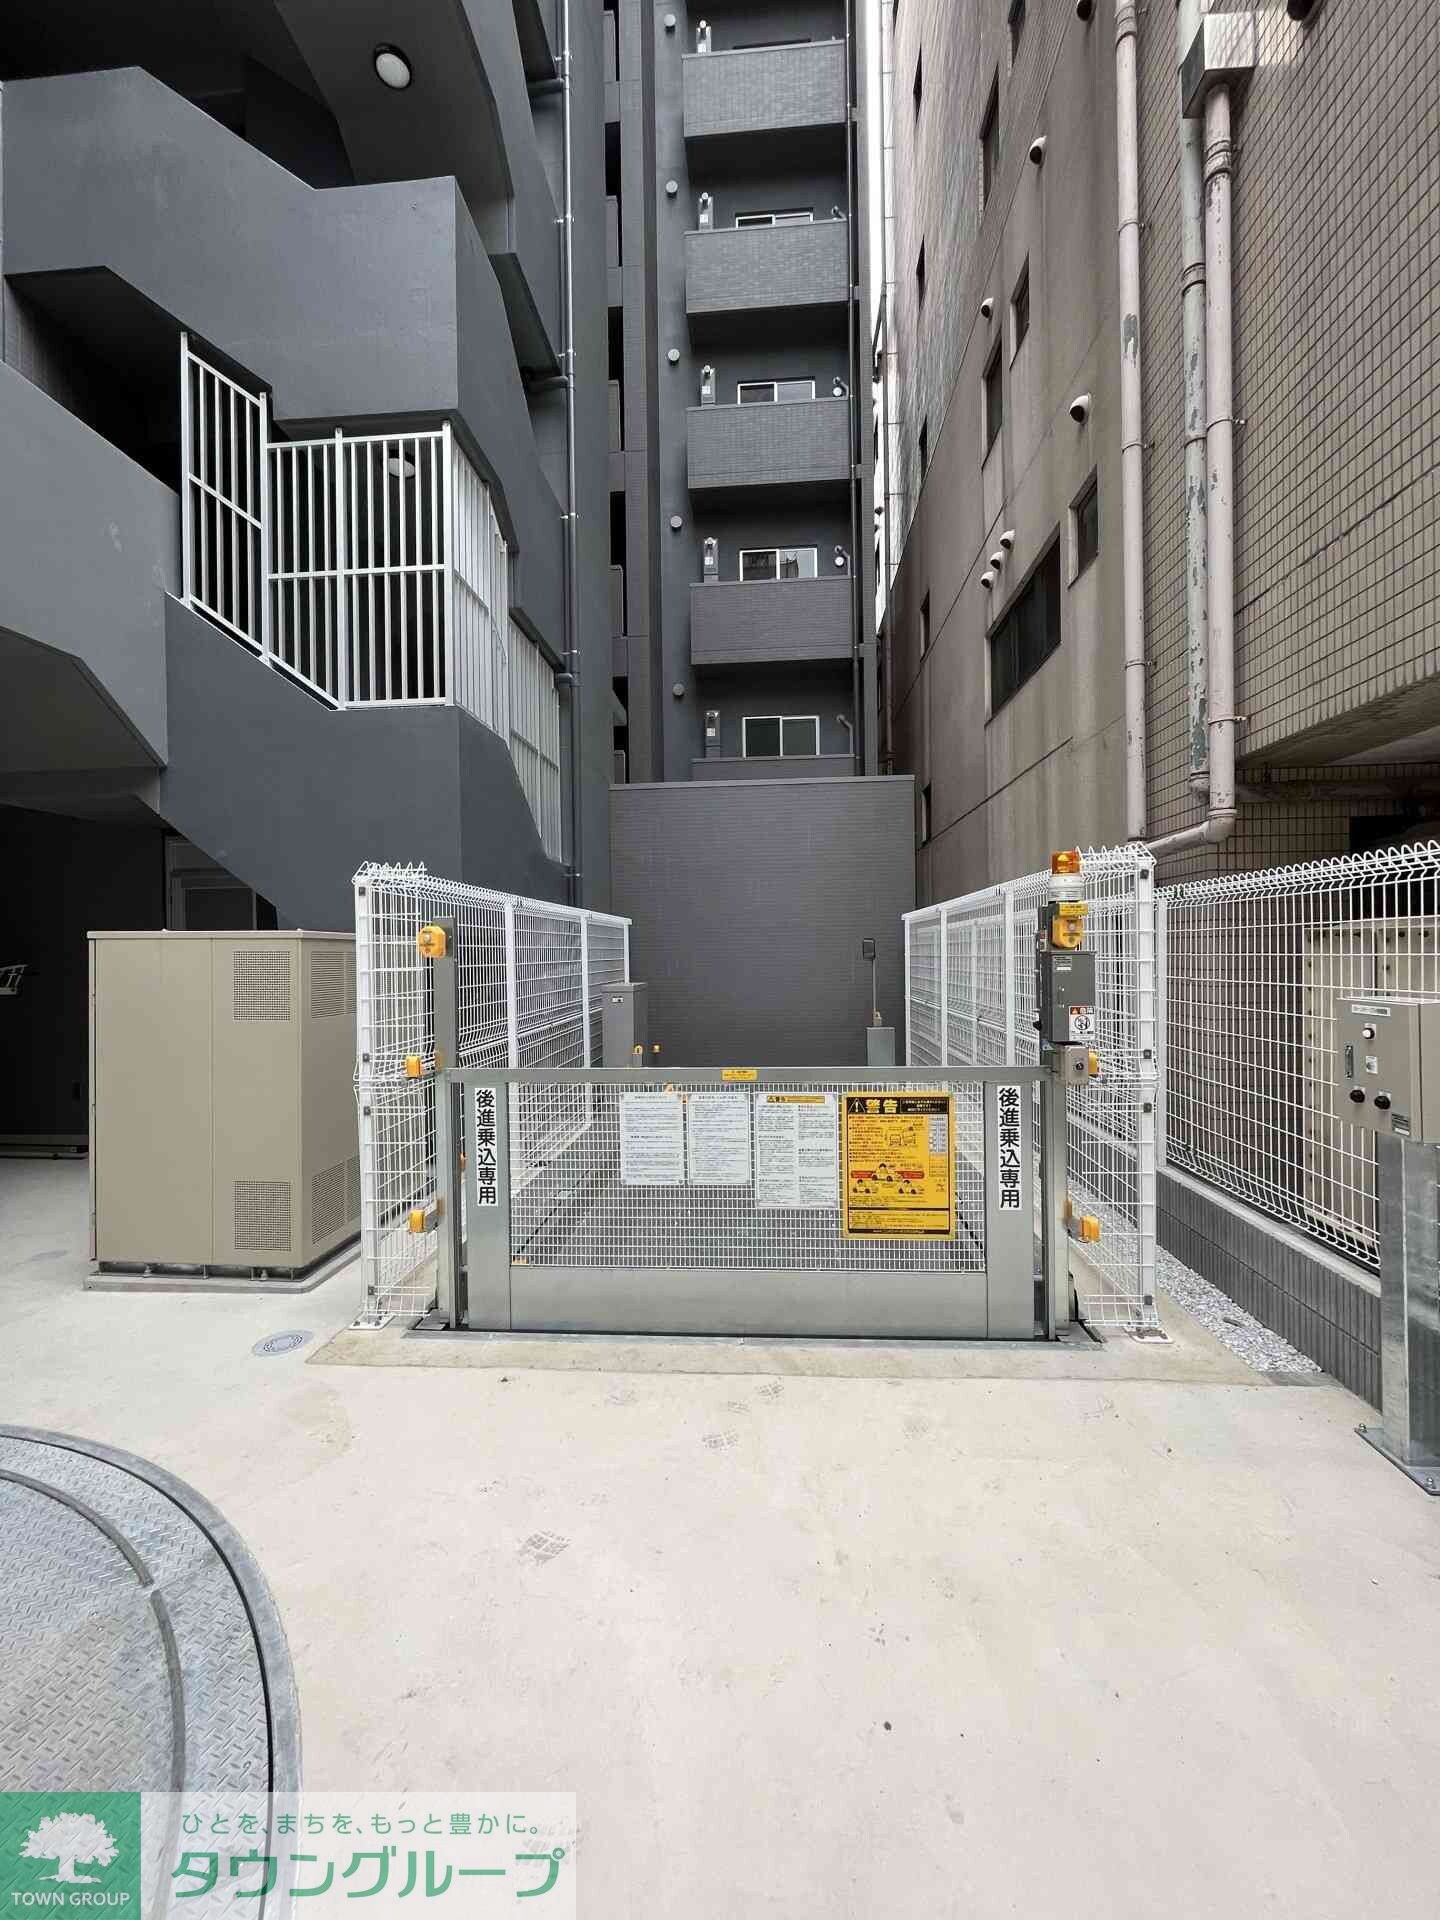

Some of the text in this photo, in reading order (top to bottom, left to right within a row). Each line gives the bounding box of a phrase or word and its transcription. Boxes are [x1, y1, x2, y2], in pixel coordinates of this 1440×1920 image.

[476, 1089, 496, 1204] 後進乗込専用
[865, 1099, 898, 1113] 警告
[999, 1088, 1020, 1208] 後進乗込専用
